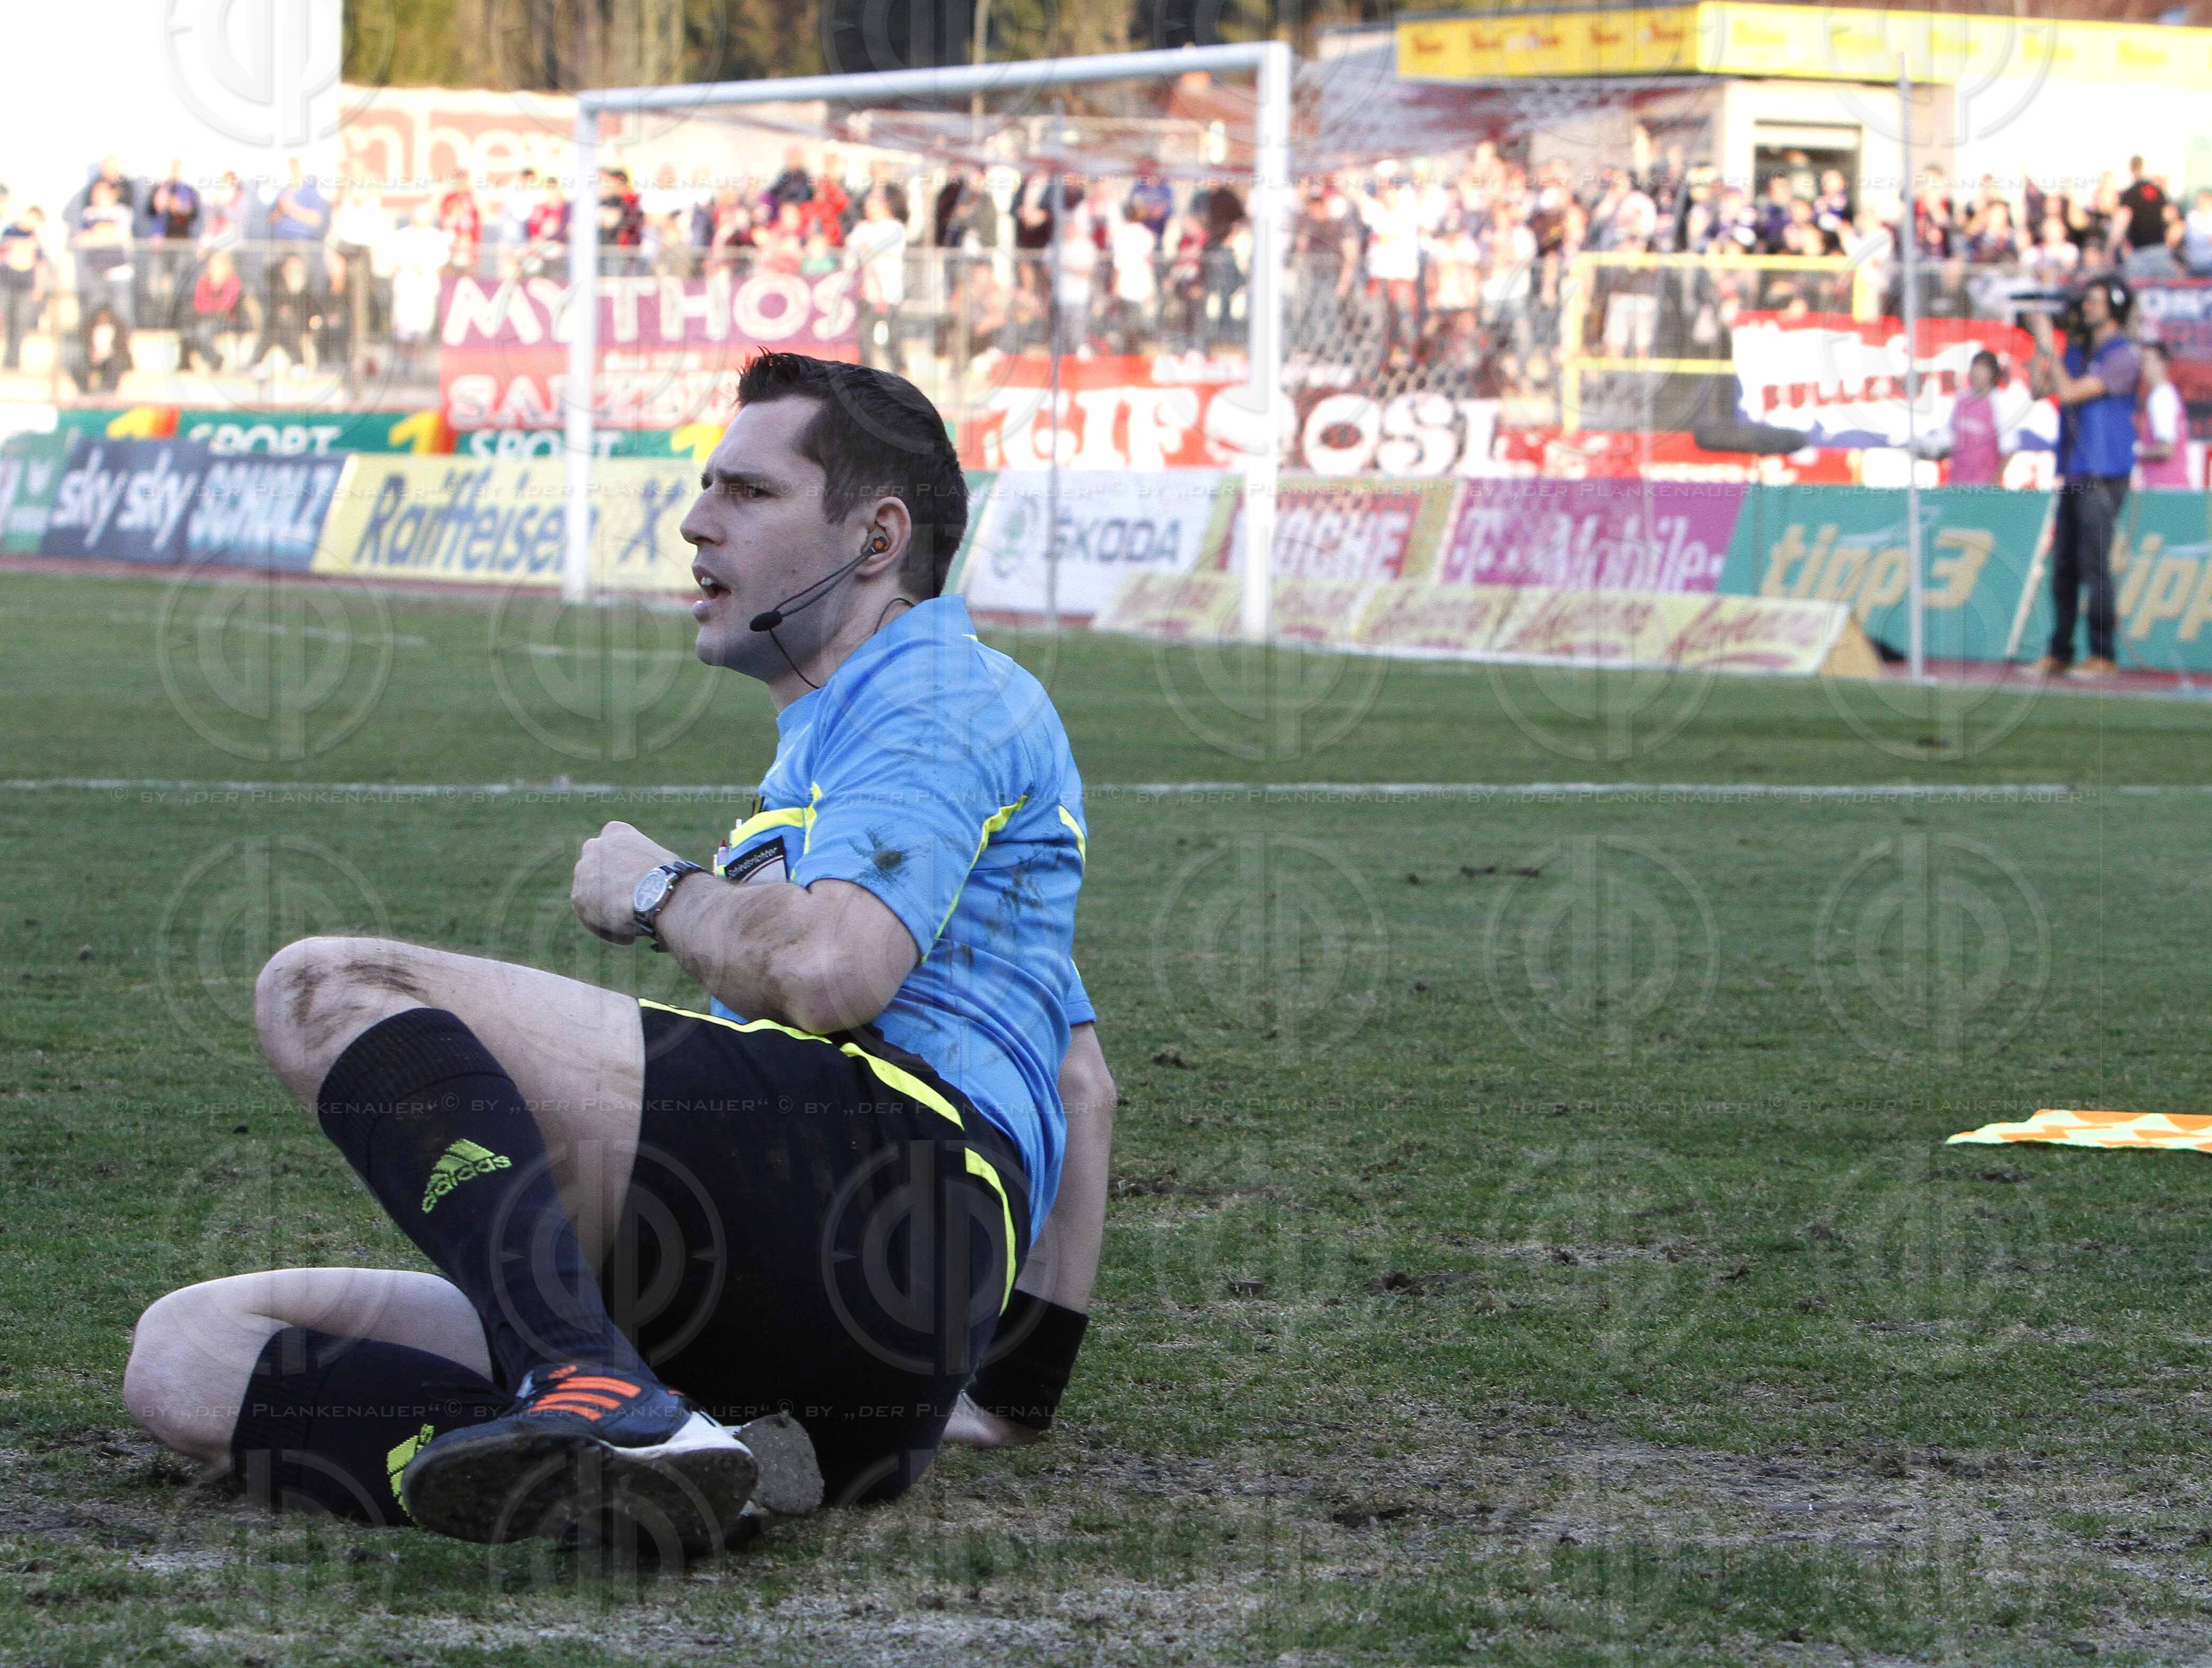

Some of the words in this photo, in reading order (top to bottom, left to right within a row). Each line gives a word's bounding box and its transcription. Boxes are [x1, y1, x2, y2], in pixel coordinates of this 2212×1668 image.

[442, 271, 857, 346] MYTHOS
[470, 431, 623, 459] SPOT
[52, 446, 126, 550] sky
[116, 447, 198, 552] sky
[1761, 524, 1995, 624] tipp3
[421, 1155, 513, 1214] adidas
